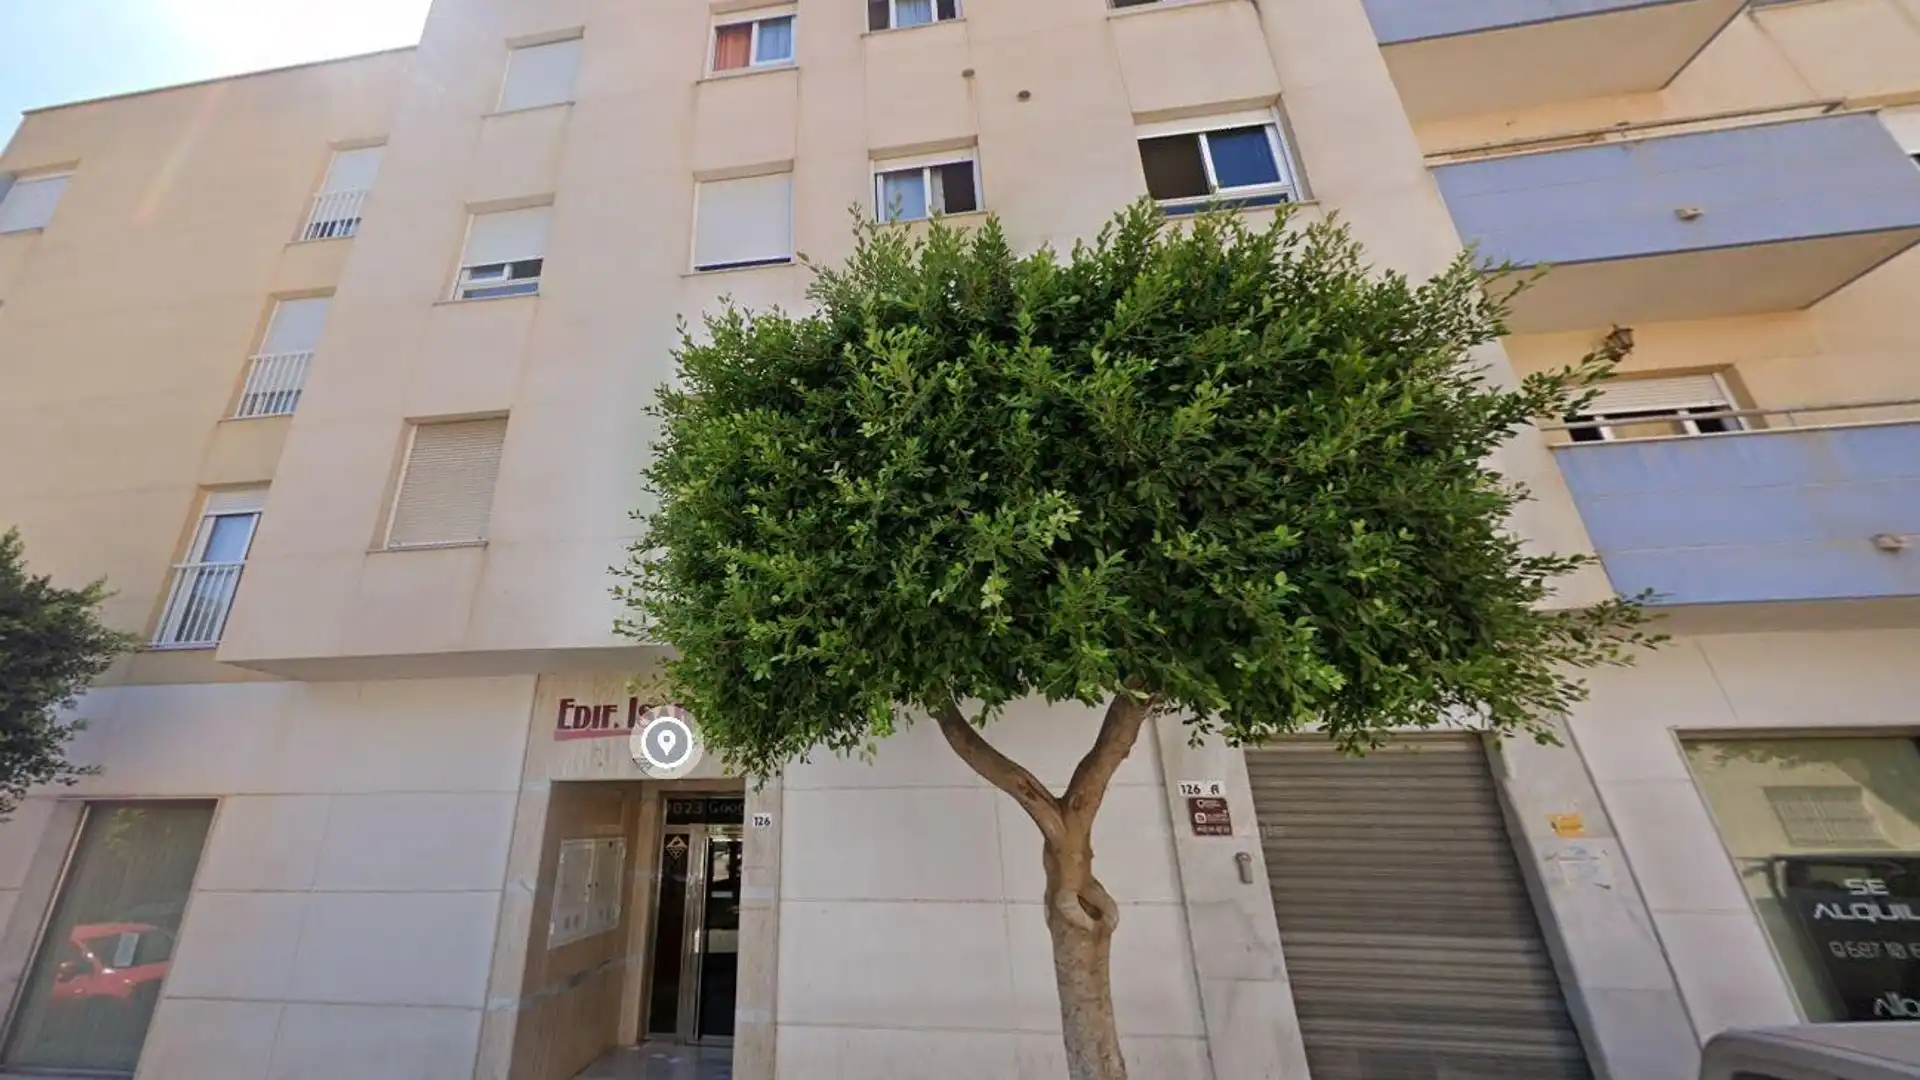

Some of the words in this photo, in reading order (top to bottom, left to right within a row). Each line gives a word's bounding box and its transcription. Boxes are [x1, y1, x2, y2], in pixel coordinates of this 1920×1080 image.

[1180, 784, 1202, 795] 126
[753, 816, 772, 827] 126
[1844, 878, 1890, 896] SE
